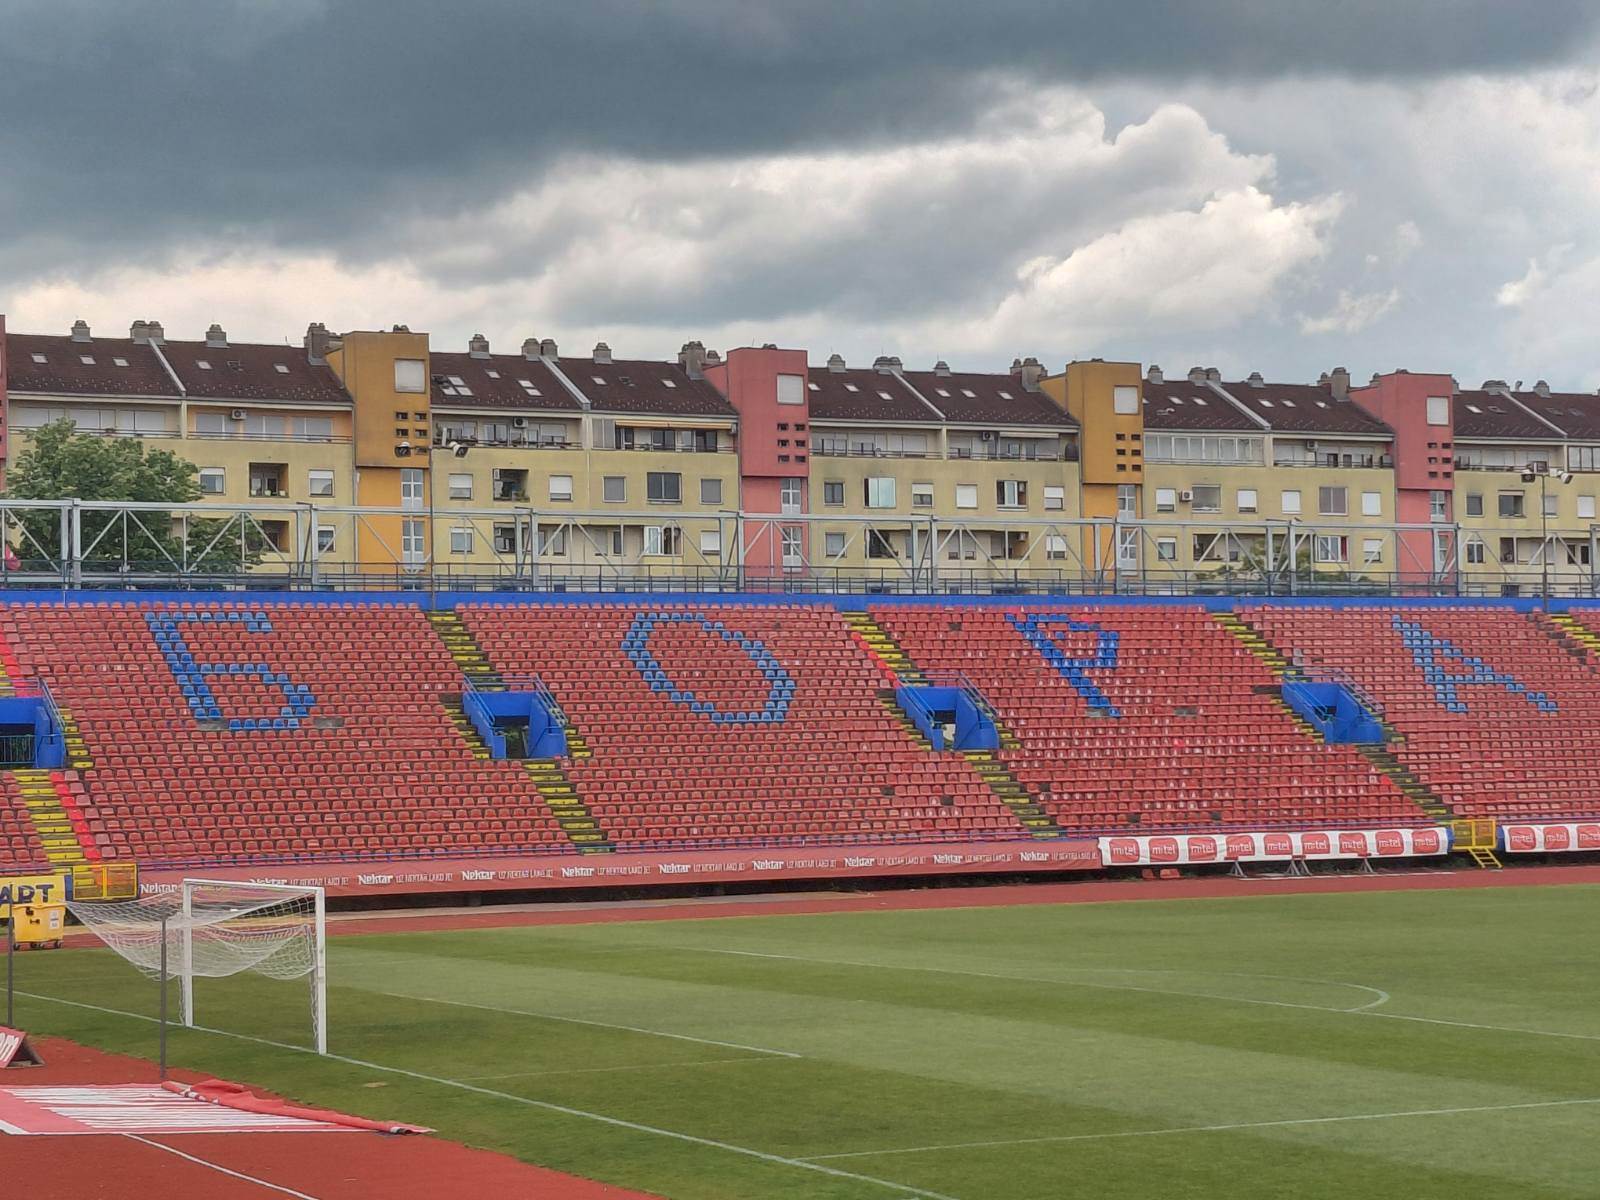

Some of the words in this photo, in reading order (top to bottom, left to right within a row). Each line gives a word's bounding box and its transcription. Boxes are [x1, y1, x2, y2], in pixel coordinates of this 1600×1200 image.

[933, 854, 963, 864] Nektar
[1020, 851, 1049, 861] Nektar
[752, 860, 784, 870] Nektar
[844, 856, 875, 867] Nektar
[562, 867, 595, 877] Nektar
[658, 863, 691, 874] Nektar
[358, 874, 393, 885] Nektar
[462, 870, 496, 880] Nektar
[141, 883, 178, 894] Nektar
